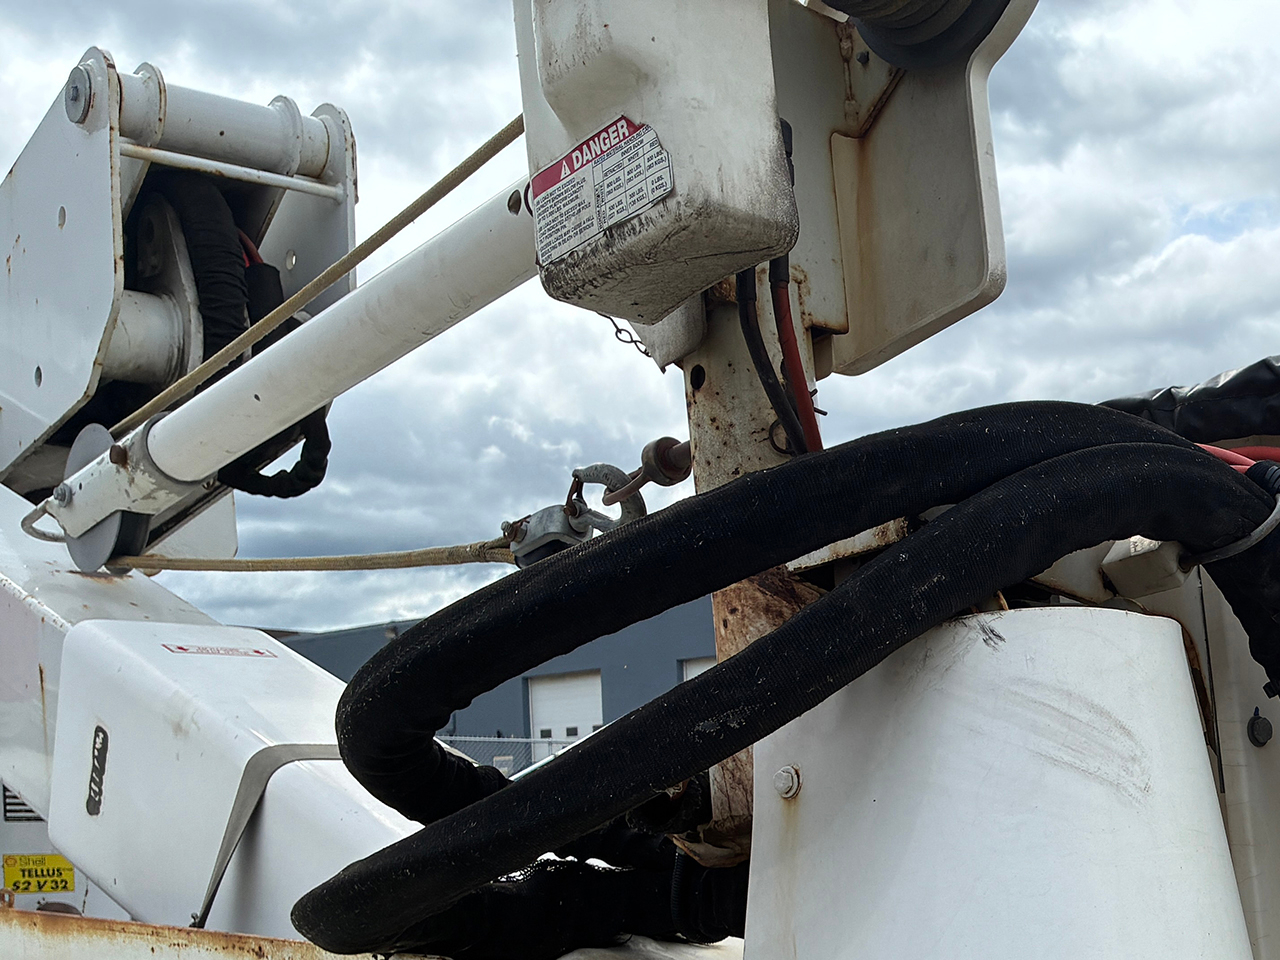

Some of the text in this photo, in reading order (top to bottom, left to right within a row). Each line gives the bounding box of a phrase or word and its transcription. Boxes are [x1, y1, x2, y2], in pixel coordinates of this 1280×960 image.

[572, 119, 629, 170] DANGER
[20, 867, 63, 878] TELLUS
[37, 880, 47, 891] V
[51, 879, 69, 891] 32
